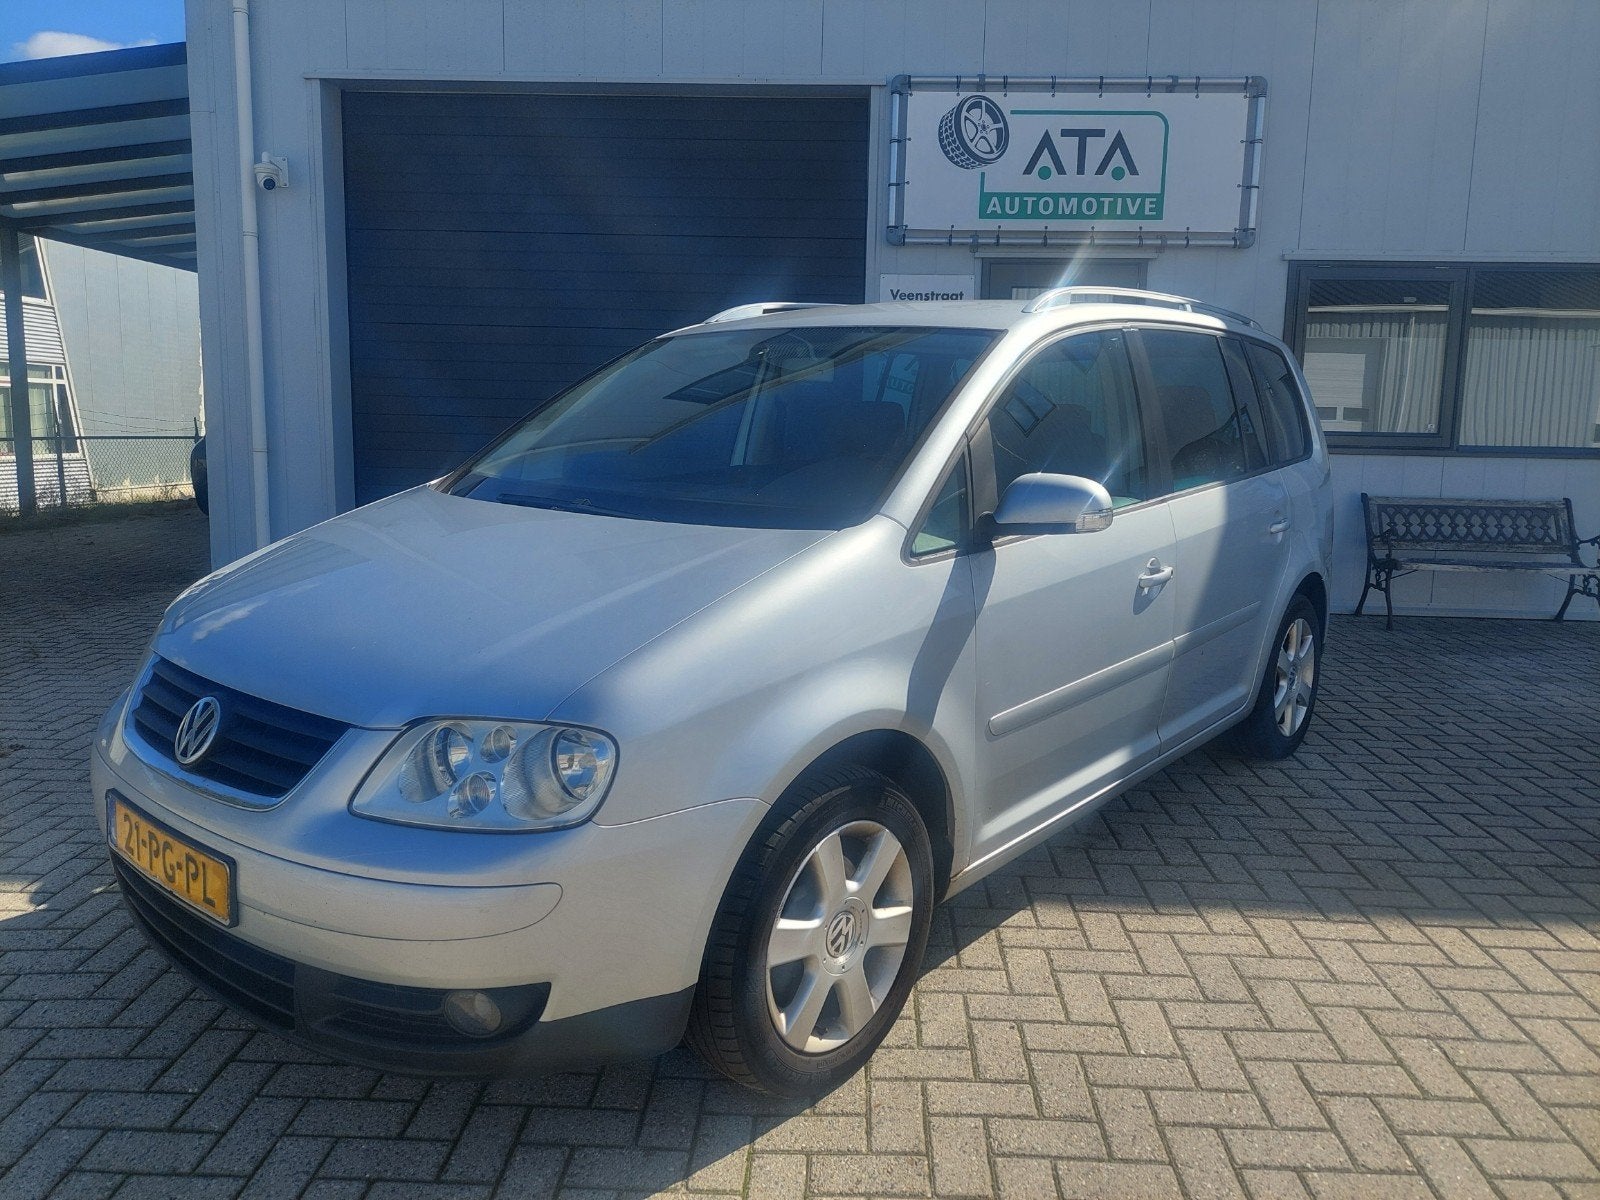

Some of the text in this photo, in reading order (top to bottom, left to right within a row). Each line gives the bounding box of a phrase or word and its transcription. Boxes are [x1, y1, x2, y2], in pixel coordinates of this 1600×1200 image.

[1022, 128, 1140, 181] ATA
[985, 196, 1158, 216] AUTOMOTIVE
[889, 288, 965, 302] Veenstraat
[123, 813, 216, 908] 21-PG-PL
